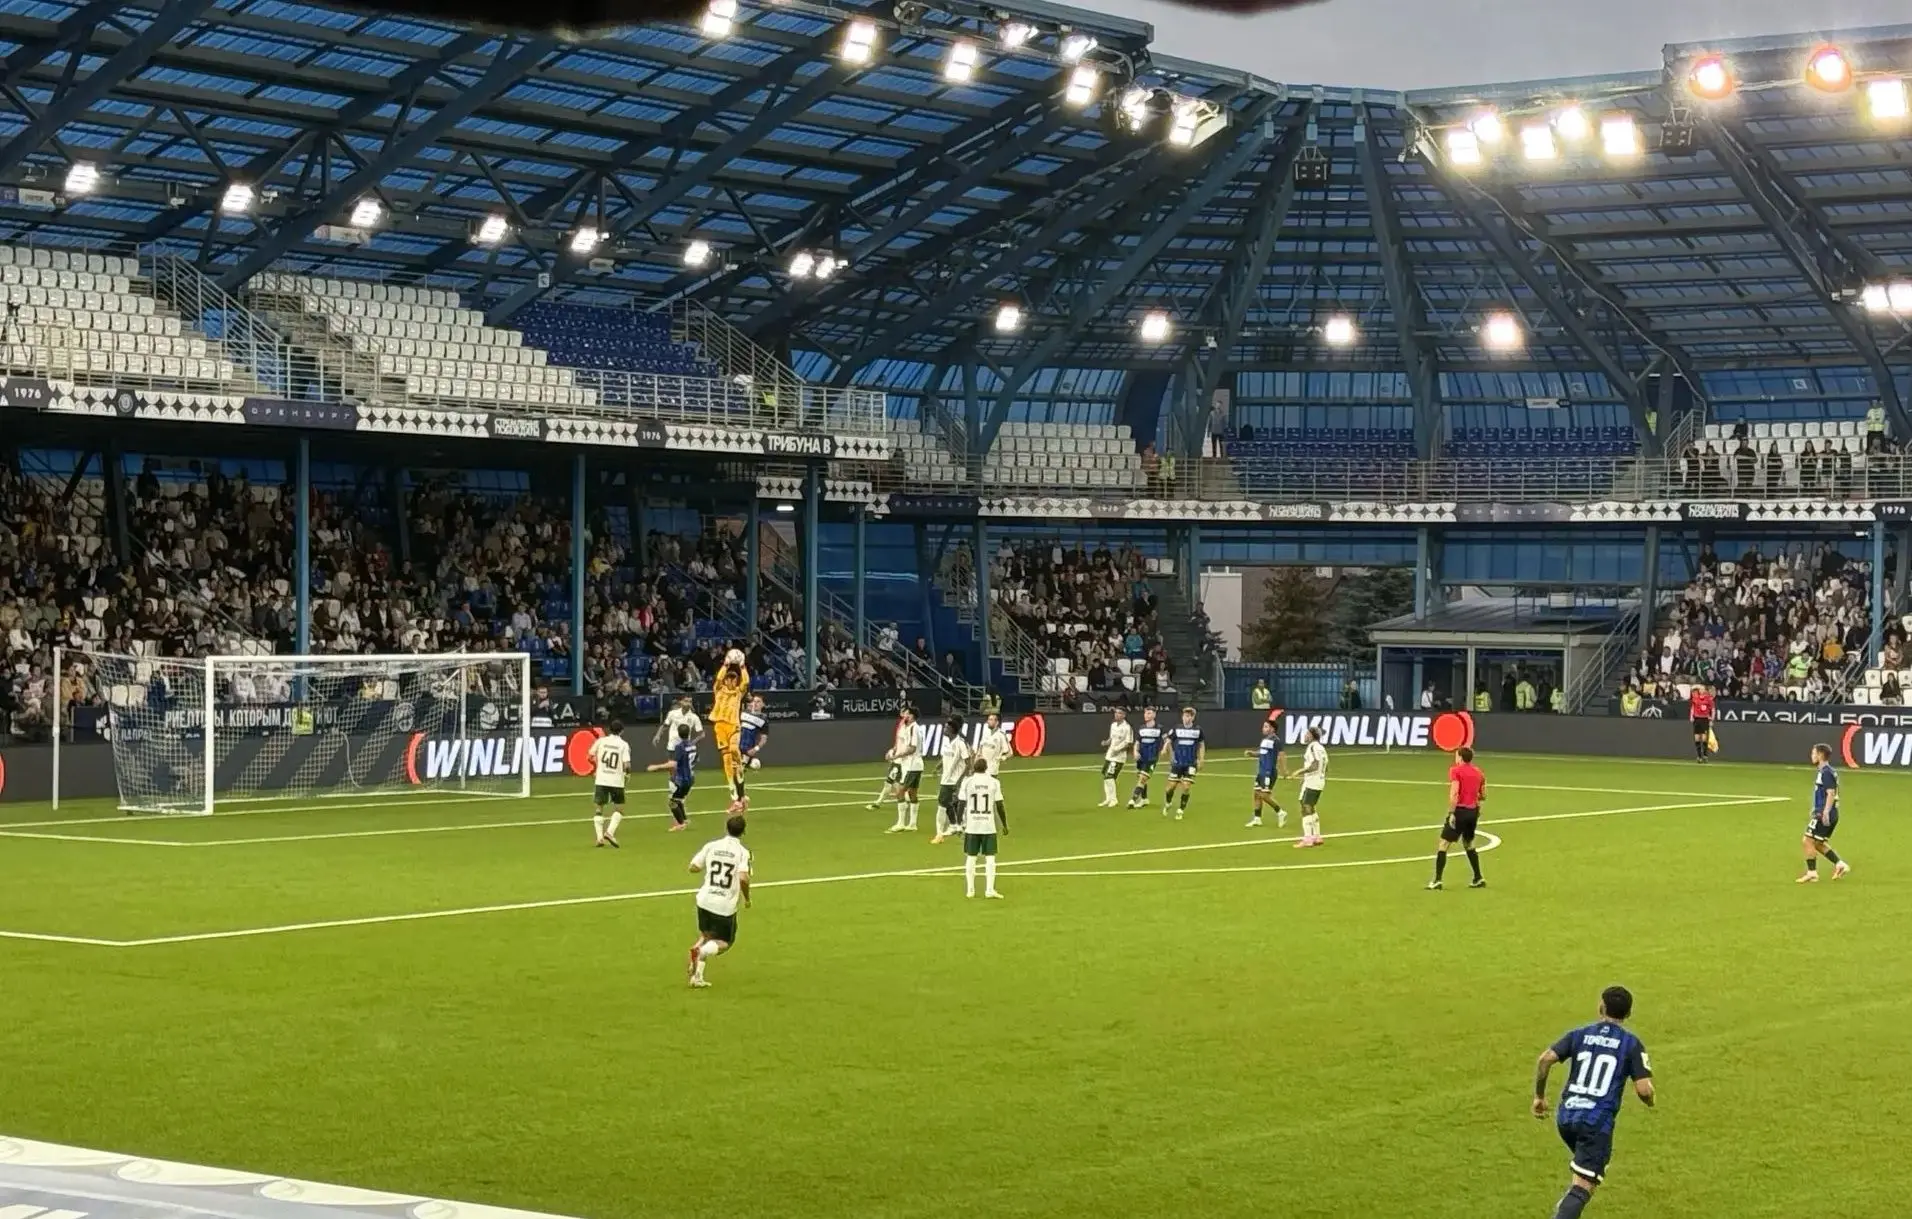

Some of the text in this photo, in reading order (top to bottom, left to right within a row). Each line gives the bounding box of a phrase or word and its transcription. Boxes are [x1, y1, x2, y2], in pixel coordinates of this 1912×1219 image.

[14, 387, 42, 399] 1976
[642, 430, 661, 441] 1976
[767, 434, 831, 454] ТРИБУНА В
[1881, 505, 1906, 515] 1976
[229, 708, 281, 727] КОТОРЫМ
[1716, 709, 1833, 725] АГАЗИН
[1285, 715, 1431, 746] WINLINE
[426, 735, 567, 778] WINLINE
[601, 750, 619, 770] 40
[970, 793, 992, 815] 11
[709, 860, 735, 889] 23
[1568, 1050, 1618, 1098] 10
